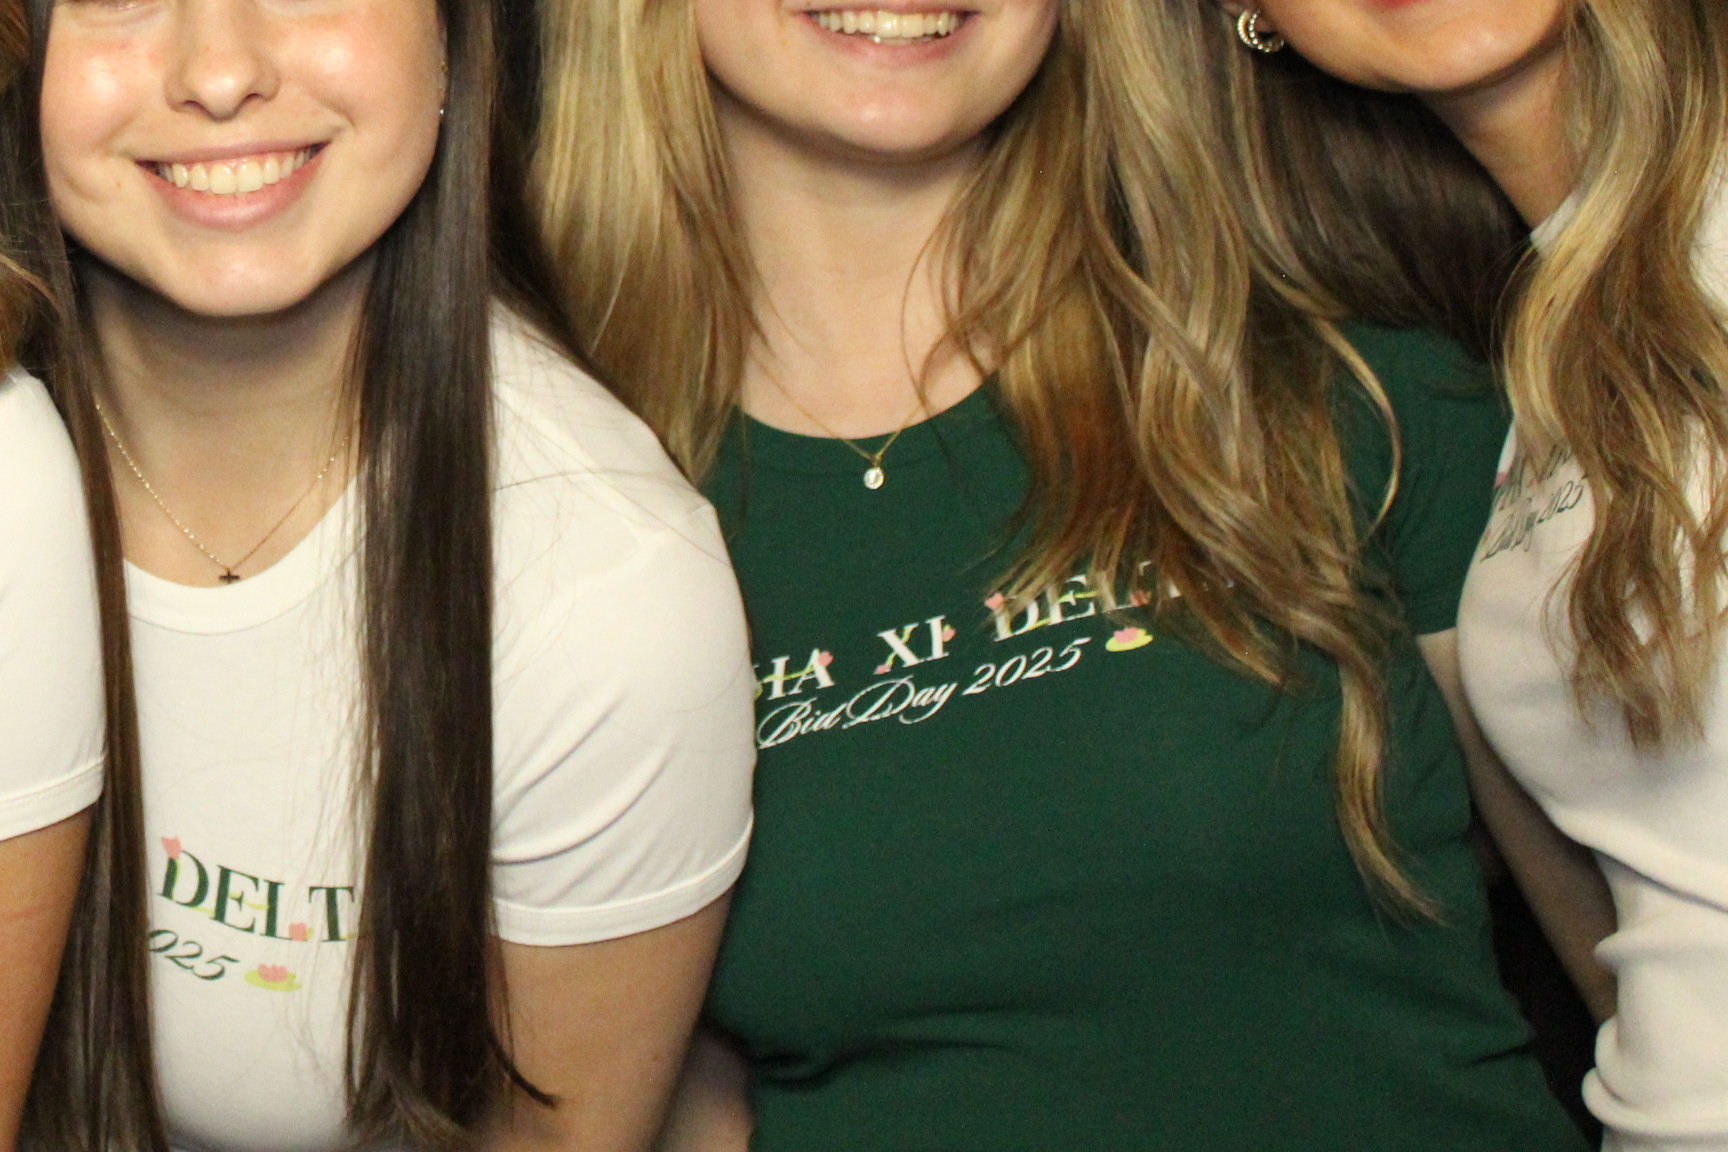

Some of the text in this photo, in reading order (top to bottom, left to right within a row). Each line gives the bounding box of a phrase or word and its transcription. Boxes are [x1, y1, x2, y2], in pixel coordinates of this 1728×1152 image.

[874, 615, 951, 675] XI
[756, 636, 1092, 749] Bid Day 2025
[148, 929, 240, 981] 025
